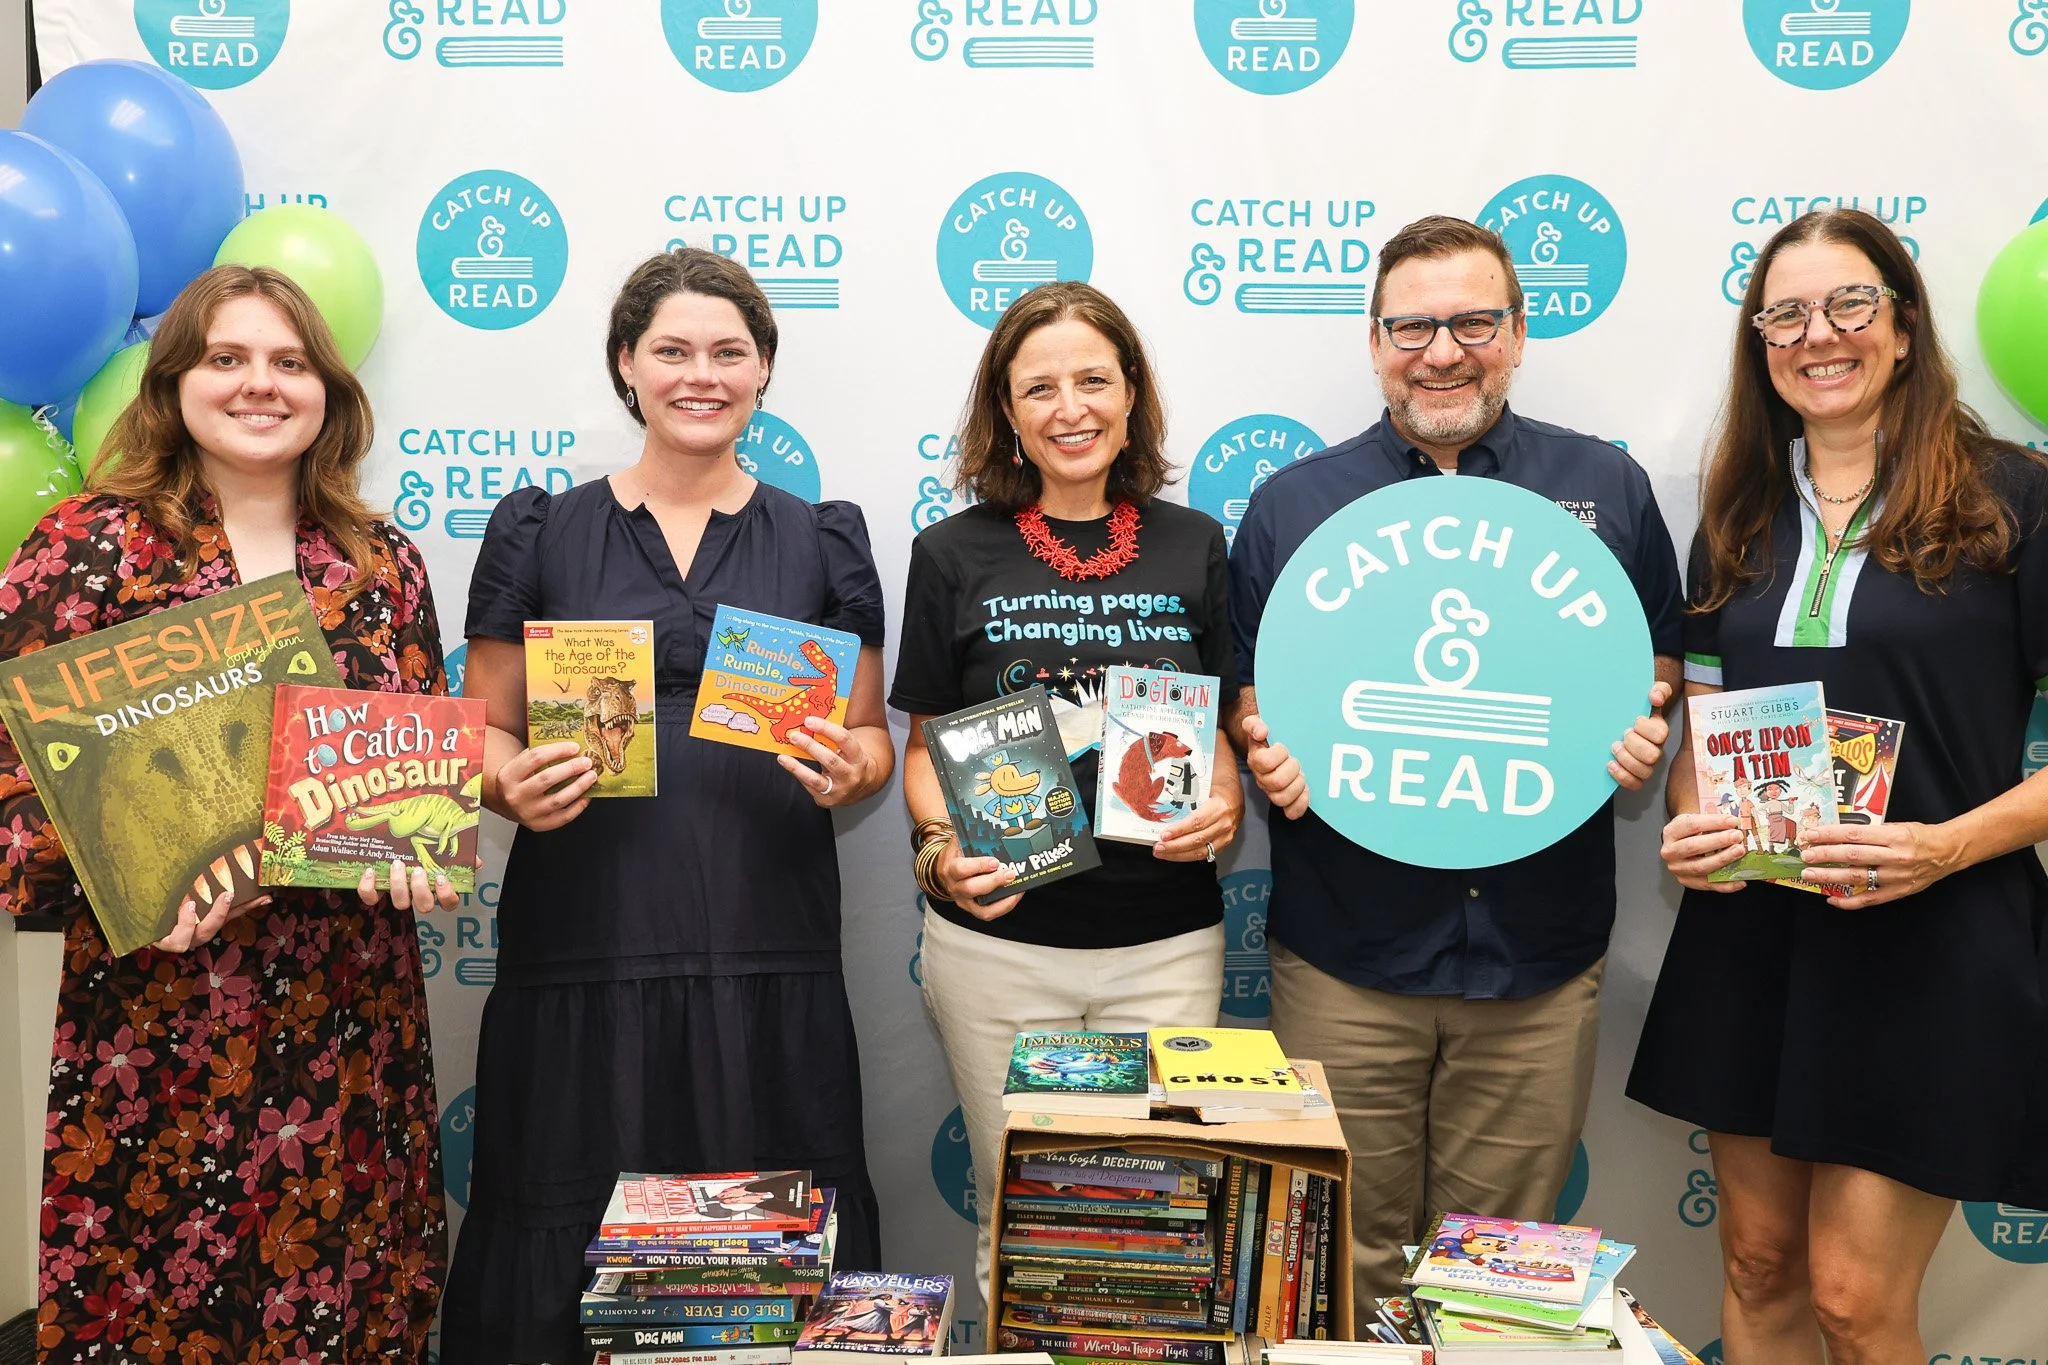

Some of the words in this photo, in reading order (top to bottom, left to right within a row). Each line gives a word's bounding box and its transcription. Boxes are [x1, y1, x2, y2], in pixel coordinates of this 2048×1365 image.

[168, 43, 258, 67] READ
[696, 45, 787, 70] READ
[1227, 46, 1320, 72] READ
[1775, 41, 1874, 67] READ
[432, 185, 510, 232] CATCH
[518, 192, 552, 230] UP
[664, 195, 784, 223] CATCH
[799, 196, 846, 223] UP
[953, 187, 1037, 235] CATCH
[1043, 193, 1078, 233] UP
[1190, 198, 1311, 227] CATCH
[1327, 199, 1376, 227] UP
[1577, 201, 1611, 234] UP
[1877, 197, 1927, 224] UP
[712, 233, 842, 268] READ
[1238, 239, 1371, 273] READ
[449, 283, 537, 309] READ
[399, 429, 516, 456] CATCH
[532, 430, 576, 456] UP
[772, 435, 805, 467] UP
[1204, 428, 1287, 474] CATCH
[1582, 501, 1595, 509] UP
[1305, 515, 1514, 612] CATCH
[1530, 550, 1608, 628] UP
[983, 589, 1095, 617] Turning
[1101, 593, 1185, 617] pages.
[564, 637, 591, 647] What
[594, 638, 615, 647] Was
[985, 617, 1122, 647] Changing
[1413, 587, 1490, 690] &
[12, 590, 300, 724] LIFESIZE
[224, 638, 270, 667] Sophy
[264, 632, 304, 656] Henn
[545, 649, 565, 660] the
[569, 649, 593, 665] Age
[596, 648, 611, 660] of
[615, 648, 635, 660] the
[746, 639, 805, 672] Rumble,
[554, 661, 627, 675] Dinosaurs?
[723, 653, 784, 681] Rumble,
[715, 674, 787, 697] Dinosaur
[94, 661, 263, 737] DINOSAURS
[1711, 707, 1754, 720] STUART
[1760, 701, 1799, 714] GIBBS
[303, 702, 369, 740] How
[997, 705, 1044, 741] MAN
[303, 744, 338, 775] to
[343, 713, 434, 765] Catch
[442, 728, 459, 752] a
[1707, 729, 1755, 757] ONCE
[1759, 724, 1812, 752] UPON
[1328, 743, 1555, 816] READ
[1733, 756, 1747, 782] A
[288, 757, 468, 832] Dinosaur
[1047, 791, 1070, 802] MAJOR
[1048, 796, 1072, 807] MOTION
[310, 844, 330, 853] Adam
[331, 845, 357, 856] Wallace
[366, 850, 384, 859] Andy
[1047, 865, 1062, 873] COMIC
[1021, 1037, 1143, 1049] IMMORTALS
[1169, 1075, 1290, 1086] GHOST
[1046, 1152, 1067, 1162] Van
[1069, 1153, 1099, 1170] Gogh
[1102, 1156, 1166, 1172] DECEPTION
[1074, 1170, 1087, 1179] Tale
[1087, 1172, 1096, 1181] of
[1099, 1170, 1153, 1185] Despereaux
[1230, 1165, 1242, 1195] BROTHER
[1227, 1196, 1238, 1218] BLACK
[1289, 1208, 1302, 1228] TWO
[693, 1239, 720, 1248] Beep!
[722, 1238, 748, 1248] Beep!
[1224, 1219, 1236, 1252] BROTHER,
[1267, 1221, 1283, 1254] ACT
[1286, 1230, 1299, 1262] TERRIBLE
[606, 1256, 632, 1264] KWONG
[646, 1256, 667, 1265] HOW
[669, 1256, 681, 1265] TO
[682, 1256, 705, 1265] FOOL
[706, 1256, 729, 1265] YOUR
[731, 1256, 767, 1265] PARENTS
[792, 1268, 824, 1277] BROSGOL
[1222, 1253, 1231, 1275] BLACK
[831, 1276, 944, 1293] MARVELLERS
[1447, 1272, 1529, 1285] BIRTHDAY
[684, 1305, 723, 1318] EVER
[730, 1305, 750, 1317] OF
[755, 1304, 785, 1318] ISLE
[1114, 1296, 1135, 1304] TOGO
[1263, 1305, 1272, 1333] MILLER
[634, 1331, 659, 1346] DOG
[660, 1330, 684, 1345] MAN
[1041, 1339, 1053, 1347] TAE
[1054, 1339, 1078, 1348] KELLER
[1083, 1339, 1111, 1353] When
[1111, 1340, 1132, 1354] You
[1155, 1347, 1164, 1355] a
[654, 1357, 671, 1365] SILLY
